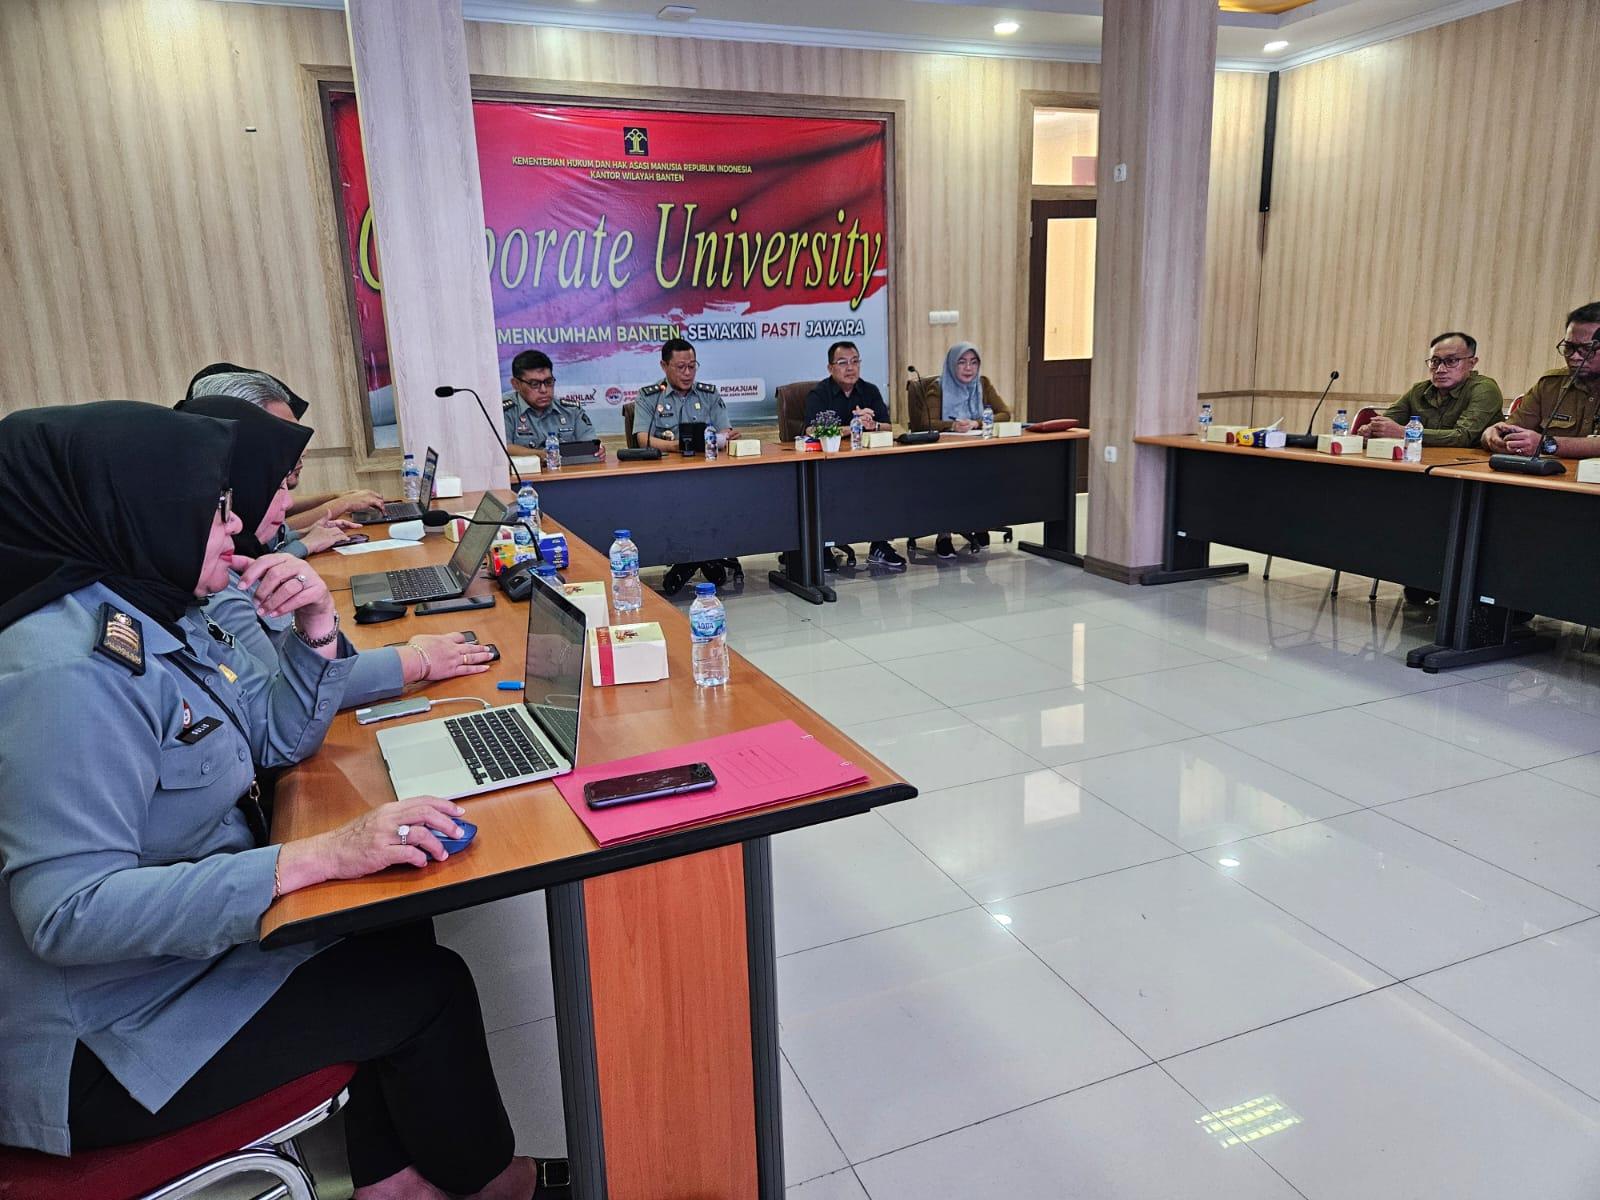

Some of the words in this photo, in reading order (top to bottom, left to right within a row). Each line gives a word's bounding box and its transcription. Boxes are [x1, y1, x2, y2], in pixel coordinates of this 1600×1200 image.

[511, 156, 565, 167] KEMENTERIAN
[567, 159, 594, 169] HUKUM
[595, 160, 612, 169] DAN
[612, 161, 628, 170] HAK
[629, 162, 650, 170] ASASI
[650, 162, 683, 171] MANUSIA
[683, 163, 716, 173] REPUBLIK
[716, 164, 753, 174] INDONESIA
[590, 170, 621, 180] KANTOR
[621, 172, 655, 181] WILAYAH
[655, 173, 685, 182] BANTEN
[358, 205, 634, 290] Corate
[655, 202, 882, 311] University
[687, 322, 757, 341] SEMAKIN
[761, 322, 801, 338] PASTI
[805, 319, 866, 338] JAWARA
[720, 384, 758, 393] PEMAJUAN
